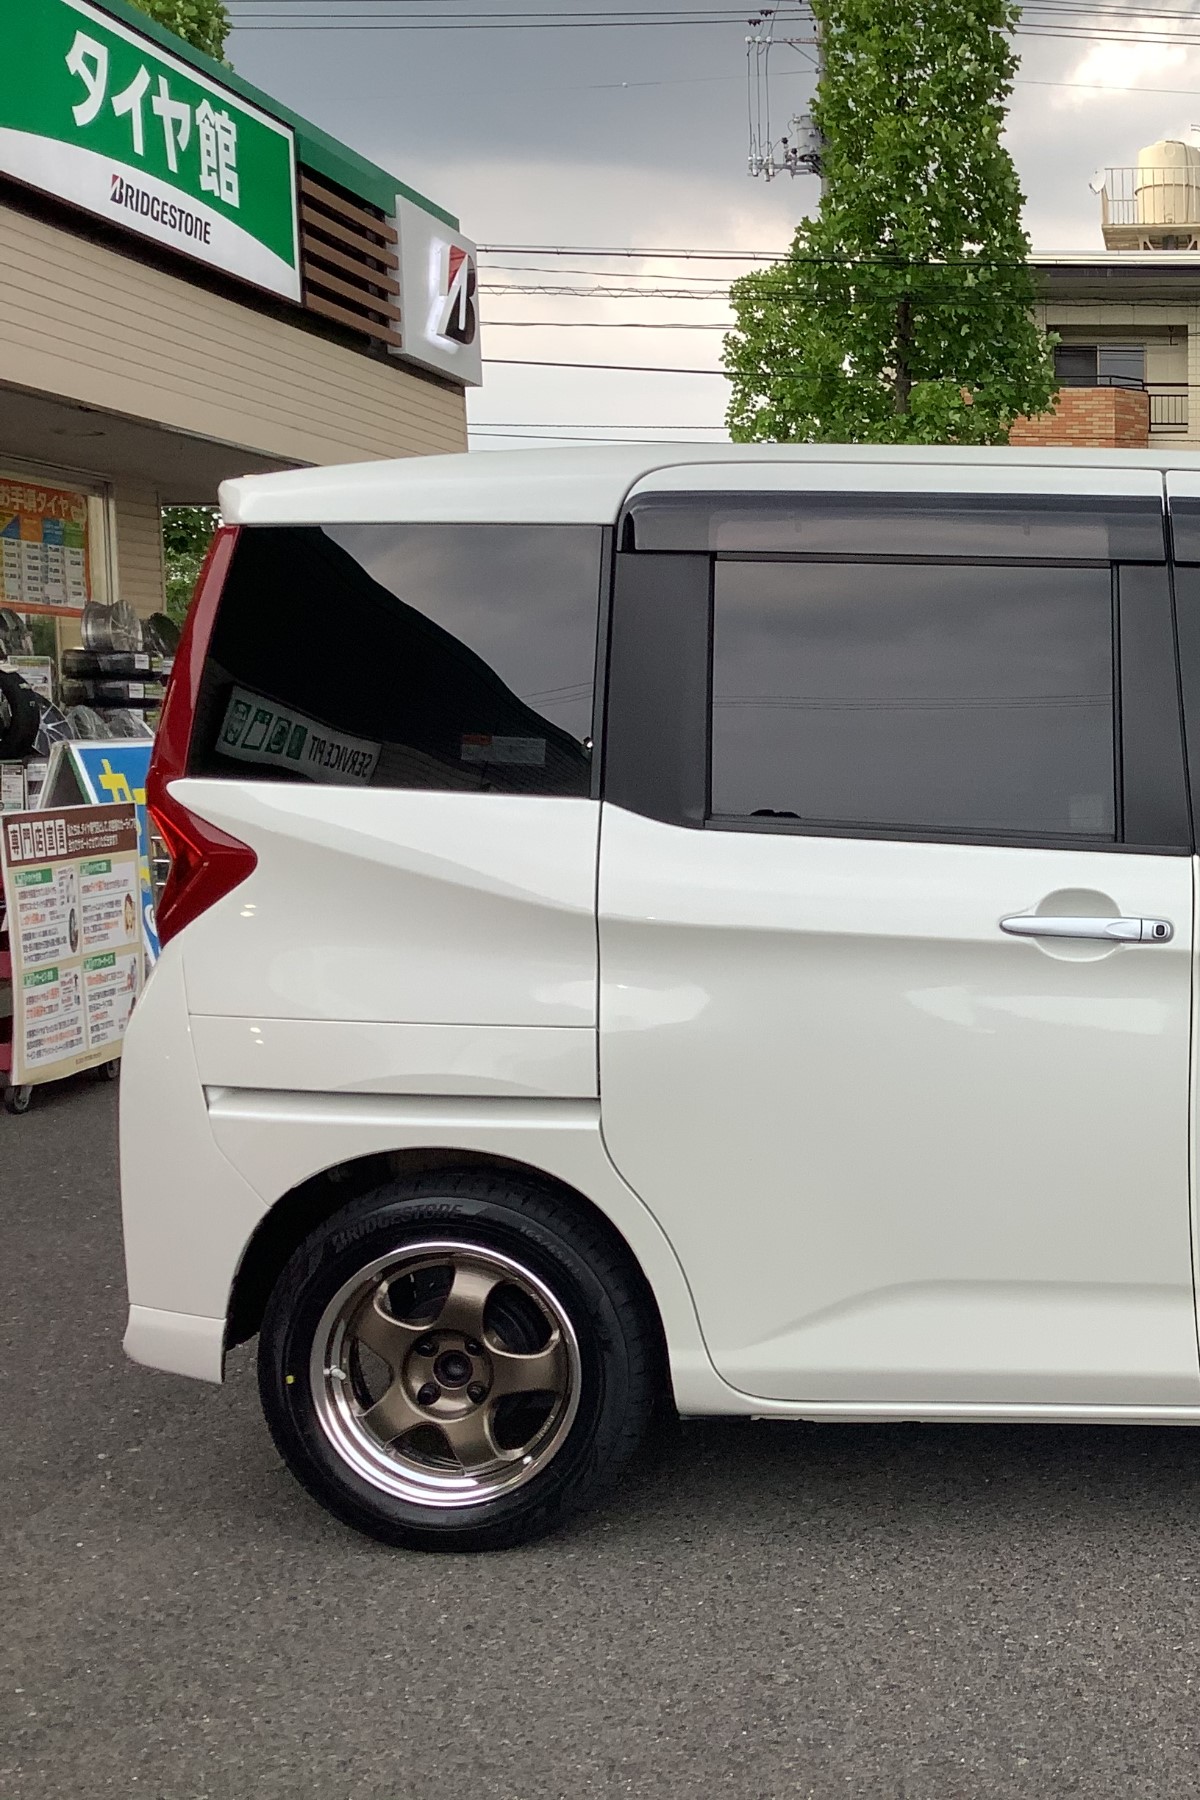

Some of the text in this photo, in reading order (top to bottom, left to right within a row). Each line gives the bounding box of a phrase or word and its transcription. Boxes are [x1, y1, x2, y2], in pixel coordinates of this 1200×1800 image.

[65, 31, 240, 208] タイヤ館
[110, 174, 211, 245] BRIDGESTONE
